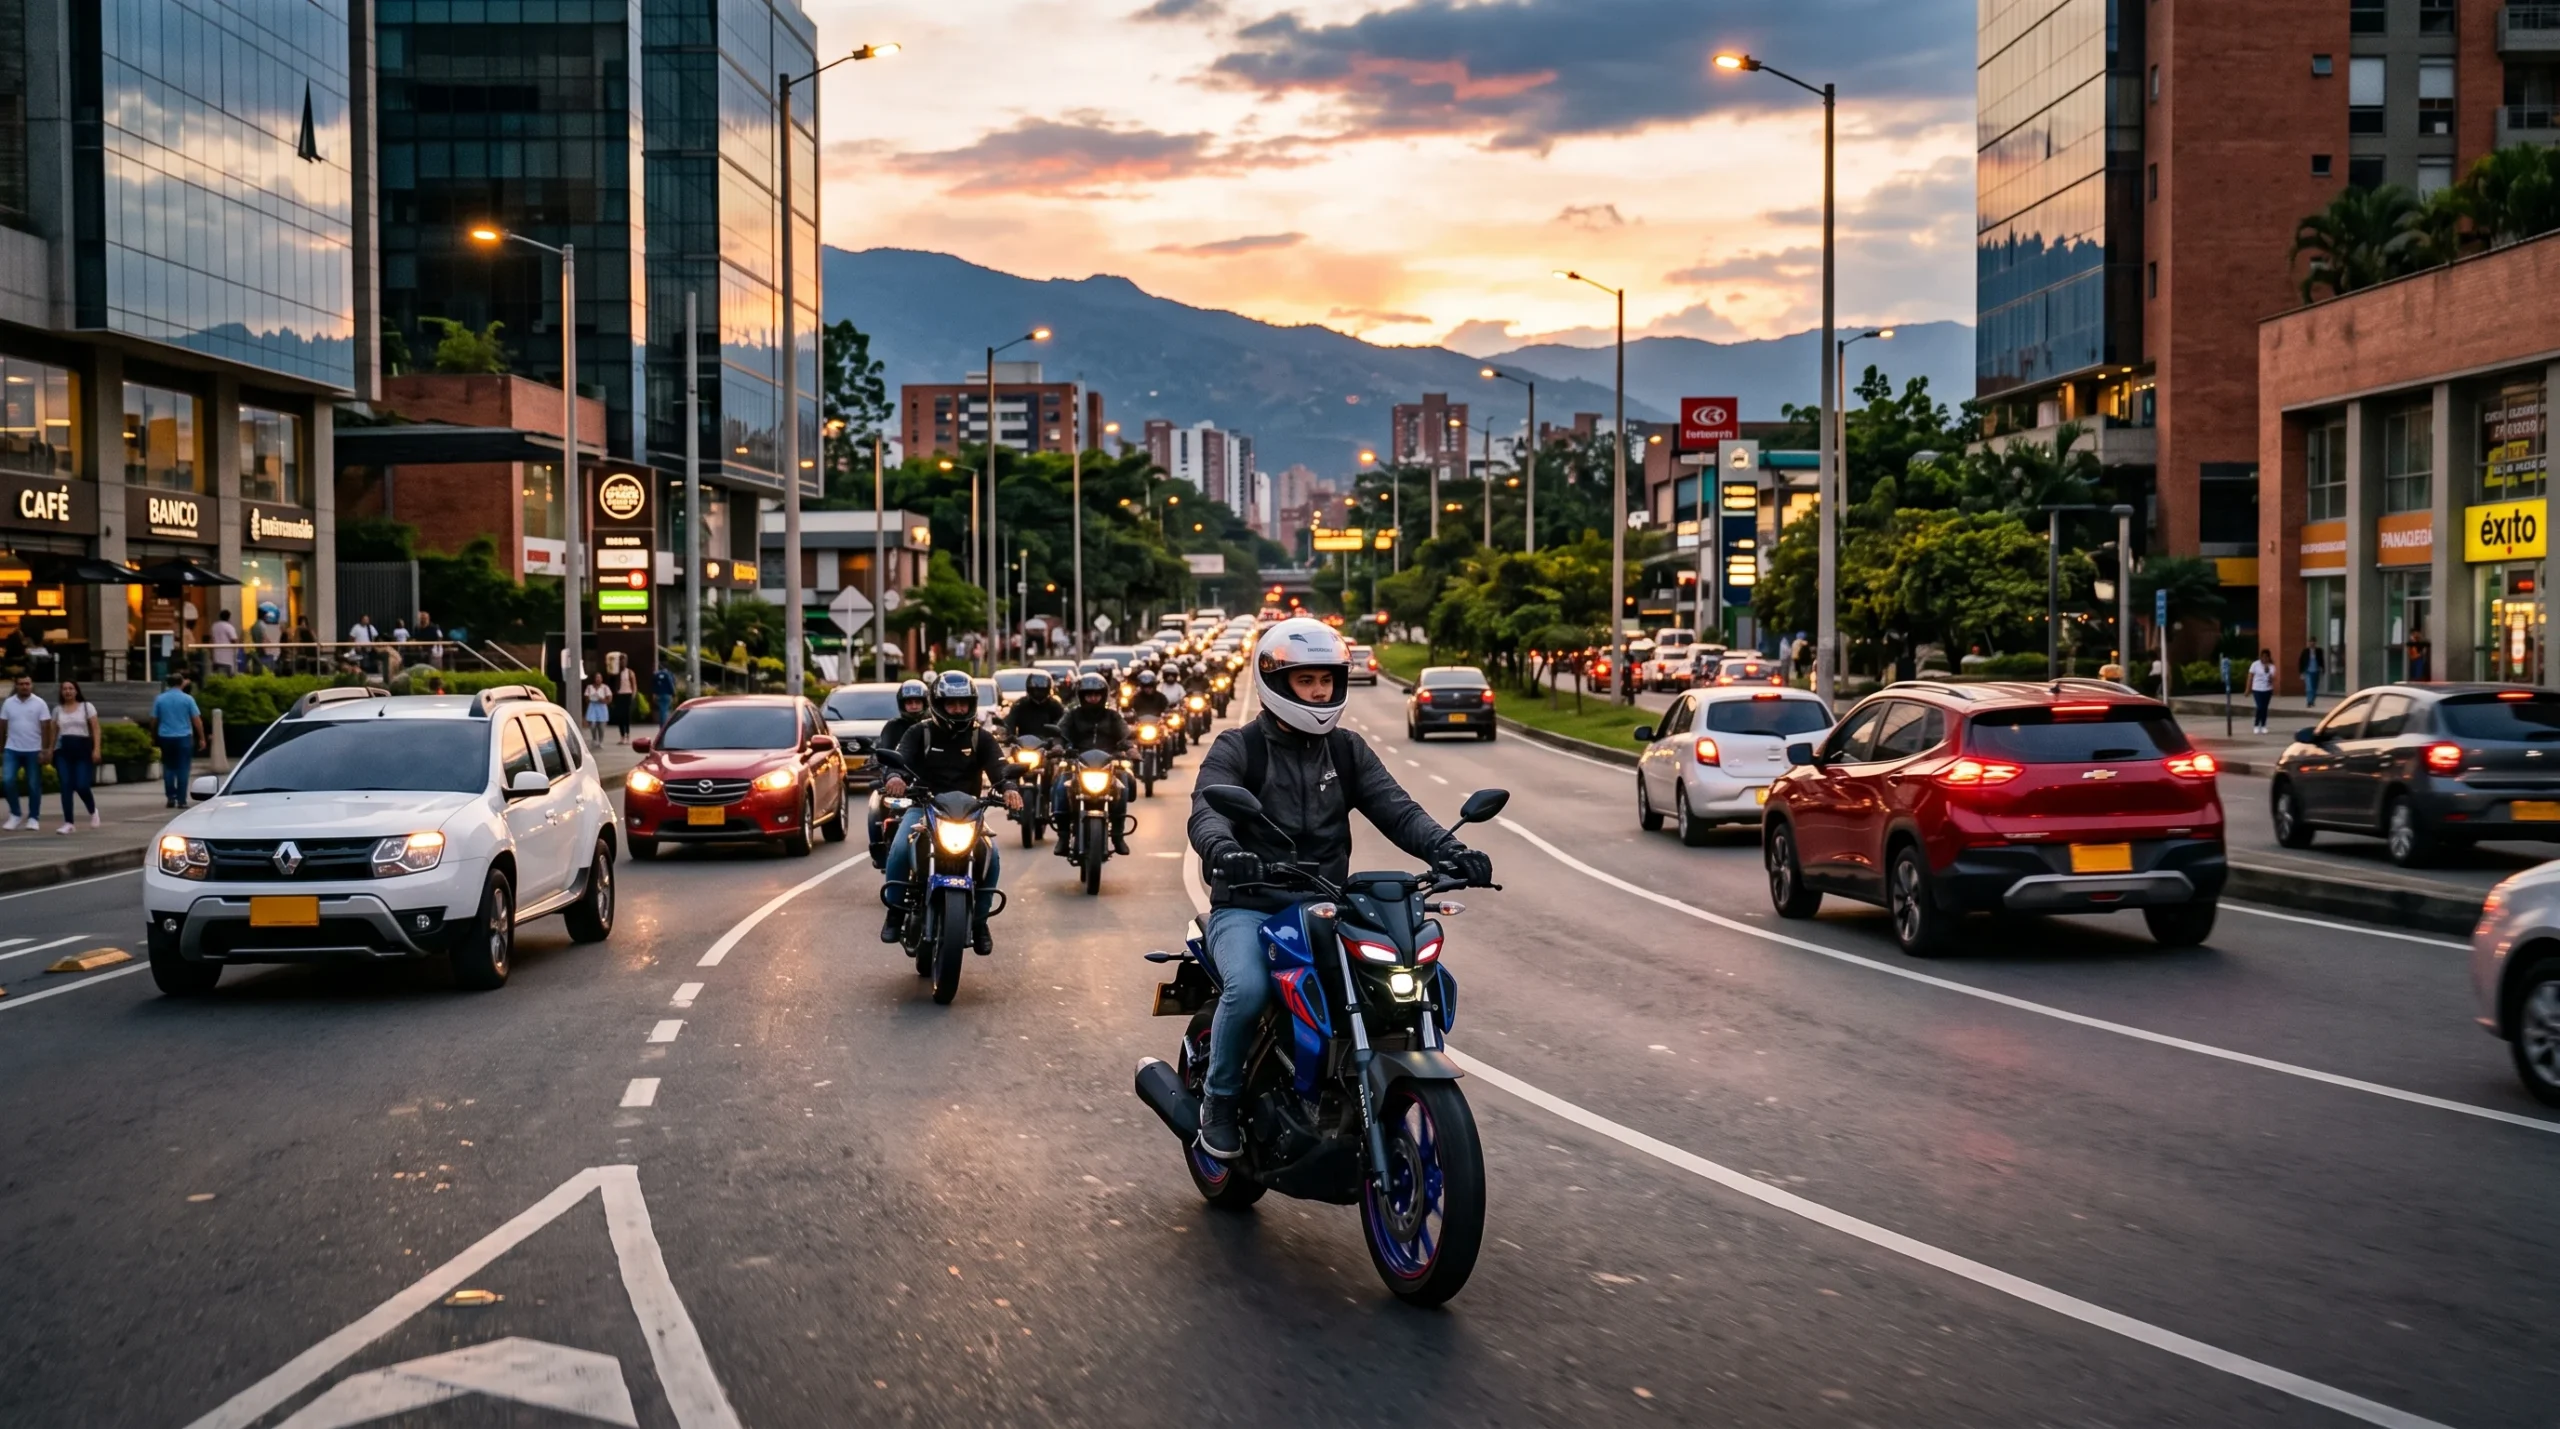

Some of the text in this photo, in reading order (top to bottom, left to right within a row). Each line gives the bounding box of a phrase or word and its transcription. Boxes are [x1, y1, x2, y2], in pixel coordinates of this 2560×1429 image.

[21, 485, 69, 521] CAFÉ
[150, 498, 198, 527] BANCO
[2481, 509, 2536, 555] éxito
